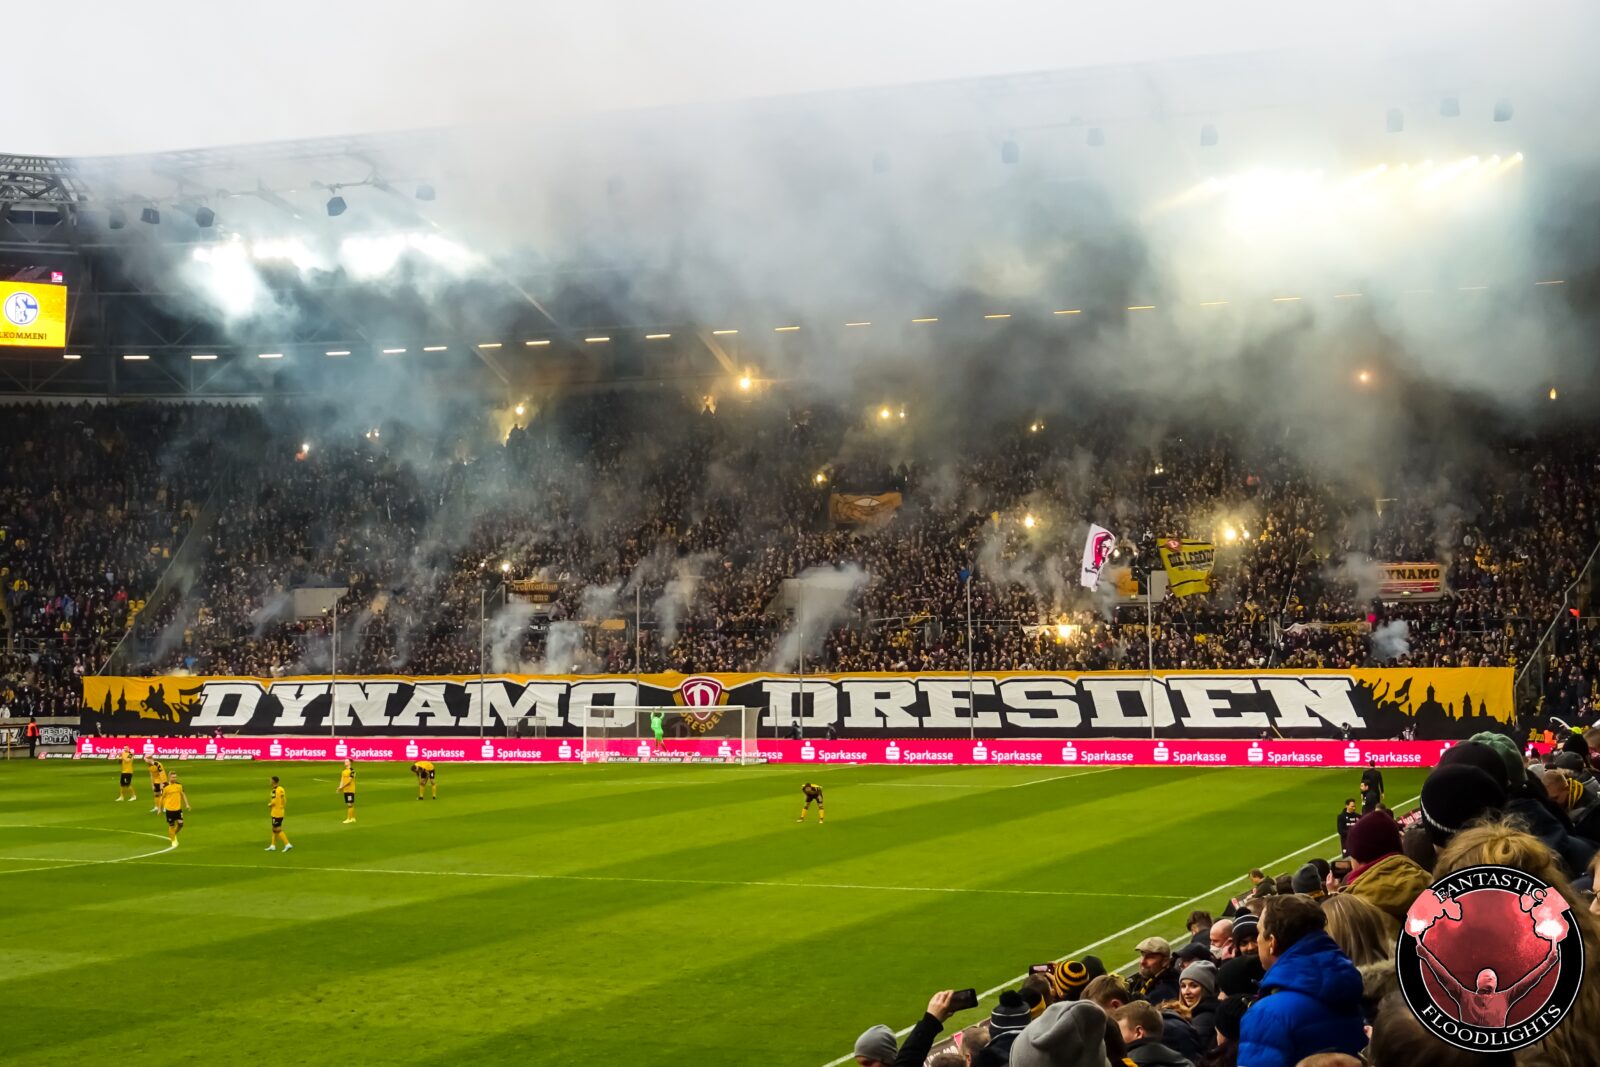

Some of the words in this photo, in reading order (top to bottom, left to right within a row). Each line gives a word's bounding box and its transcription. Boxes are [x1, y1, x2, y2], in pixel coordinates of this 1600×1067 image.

[190, 682, 637, 727] DYNAMO
[762, 678, 1367, 728] DRESDEN
[95, 746, 135, 754] Sparkae
[220, 747, 261, 756] Sparkasse
[284, 747, 327, 758] Sparkasse
[350, 747, 393, 758] Sparkasse
[421, 748, 465, 758] Sparkasse
[497, 748, 542, 759] Sparkasse
[818, 750, 867, 762] Sparkasse
[903, 750, 954, 762] Sparkasse
[991, 750, 1042, 762] Sparkasse
[1081, 751, 1134, 763] Sparkasse
[1173, 751, 1227, 763] Sparkasse
[1267, 751, 1323, 764] Sparkasse
[1364, 752, 1421, 763] Sparkasse
